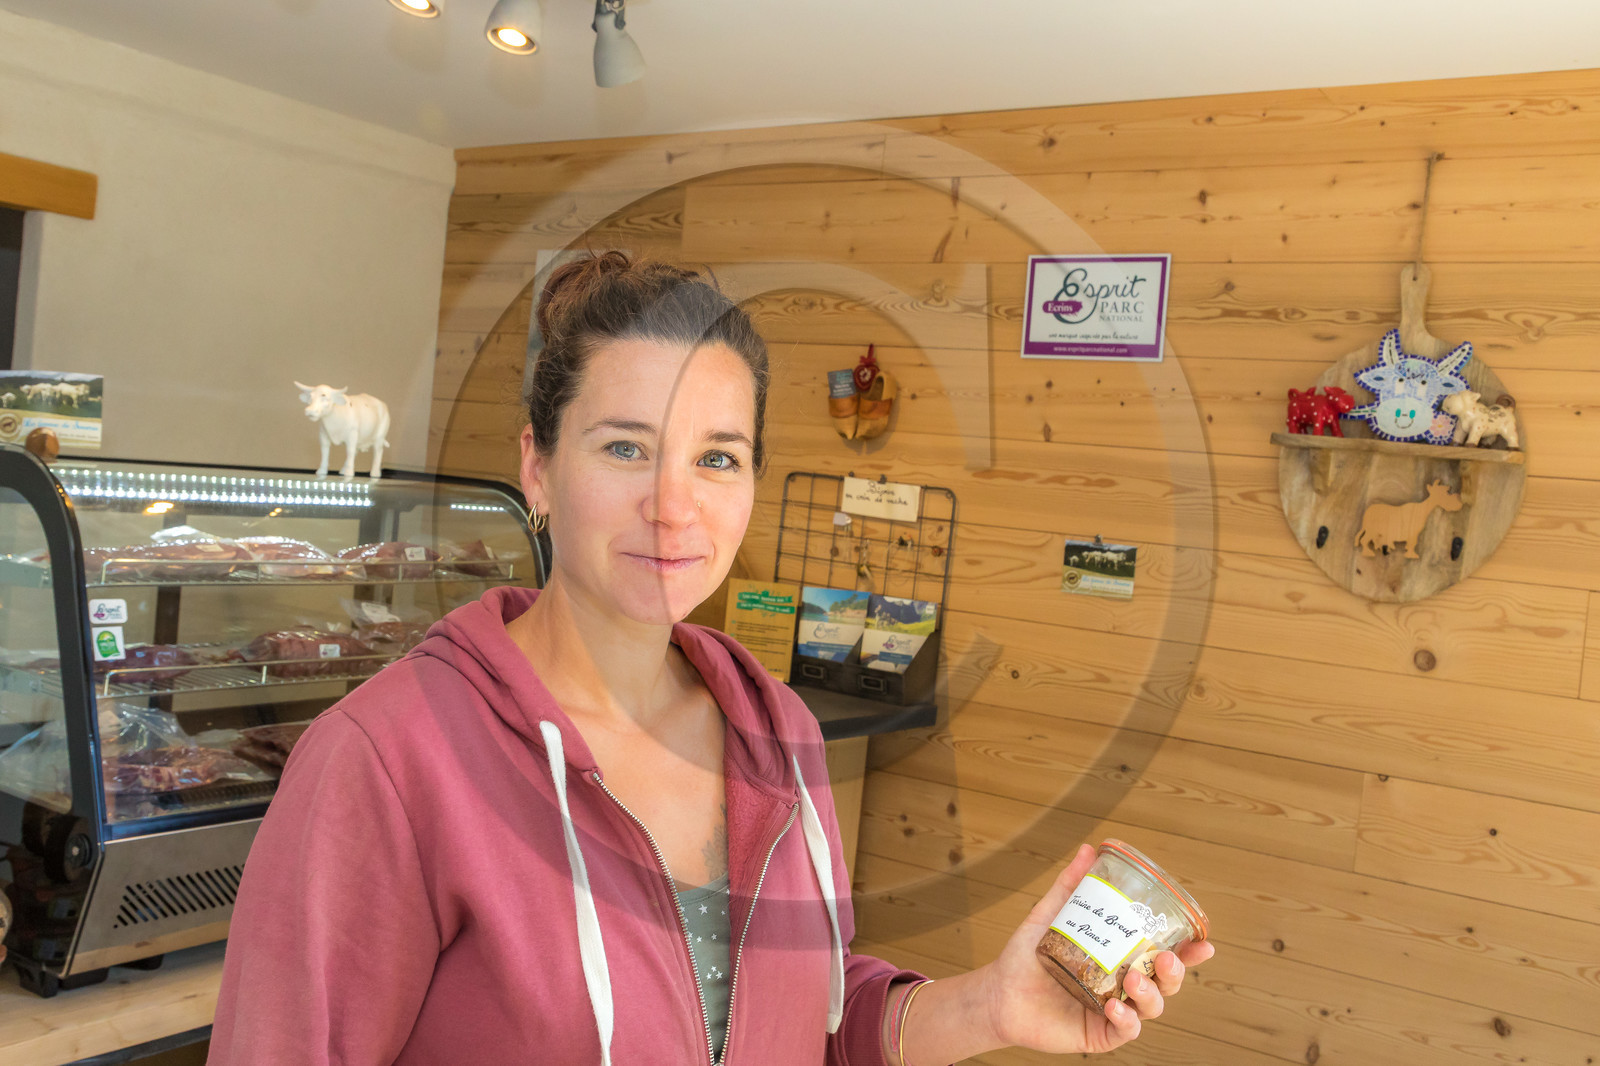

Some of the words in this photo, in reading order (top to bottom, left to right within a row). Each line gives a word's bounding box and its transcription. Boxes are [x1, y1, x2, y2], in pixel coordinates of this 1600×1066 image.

[1053, 267, 1147, 325] Esprit
[1047, 302, 1075, 313] Ecrins
[1100, 301, 1144, 314] PARC
[1053, 346, 1129, 354] www.espritparcnational.com
[1092, 907, 1104, 917] de
